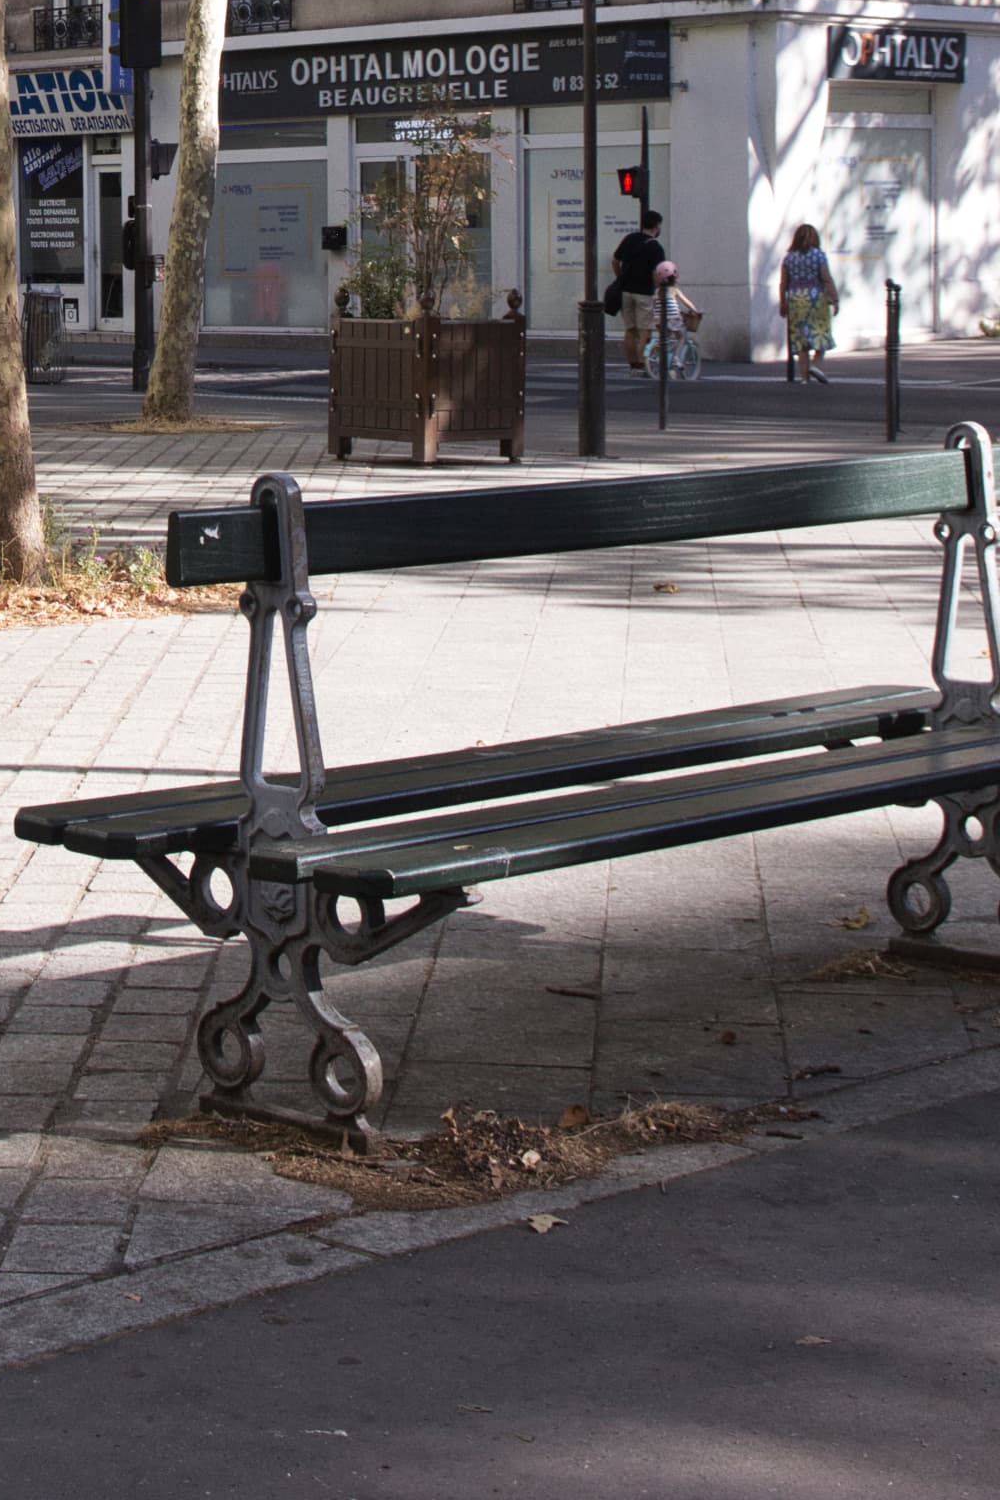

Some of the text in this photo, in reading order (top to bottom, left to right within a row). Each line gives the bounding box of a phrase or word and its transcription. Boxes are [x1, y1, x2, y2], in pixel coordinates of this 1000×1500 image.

[842, 32, 959, 70] OPHTALYS
[291, 42, 541, 86] OPHTALMOLOGIE
[221, 69, 279, 92] HTALYS
[552, 76, 565, 92] 01
[569, 74, 584, 92] 83
[319, 79, 509, 108] BEAUGRENELLE
[70, 113, 131, 133] DERATISATION
[22, 147, 41, 166] allo
[29, 208, 77, 216] TOUS DEPANNAGES
